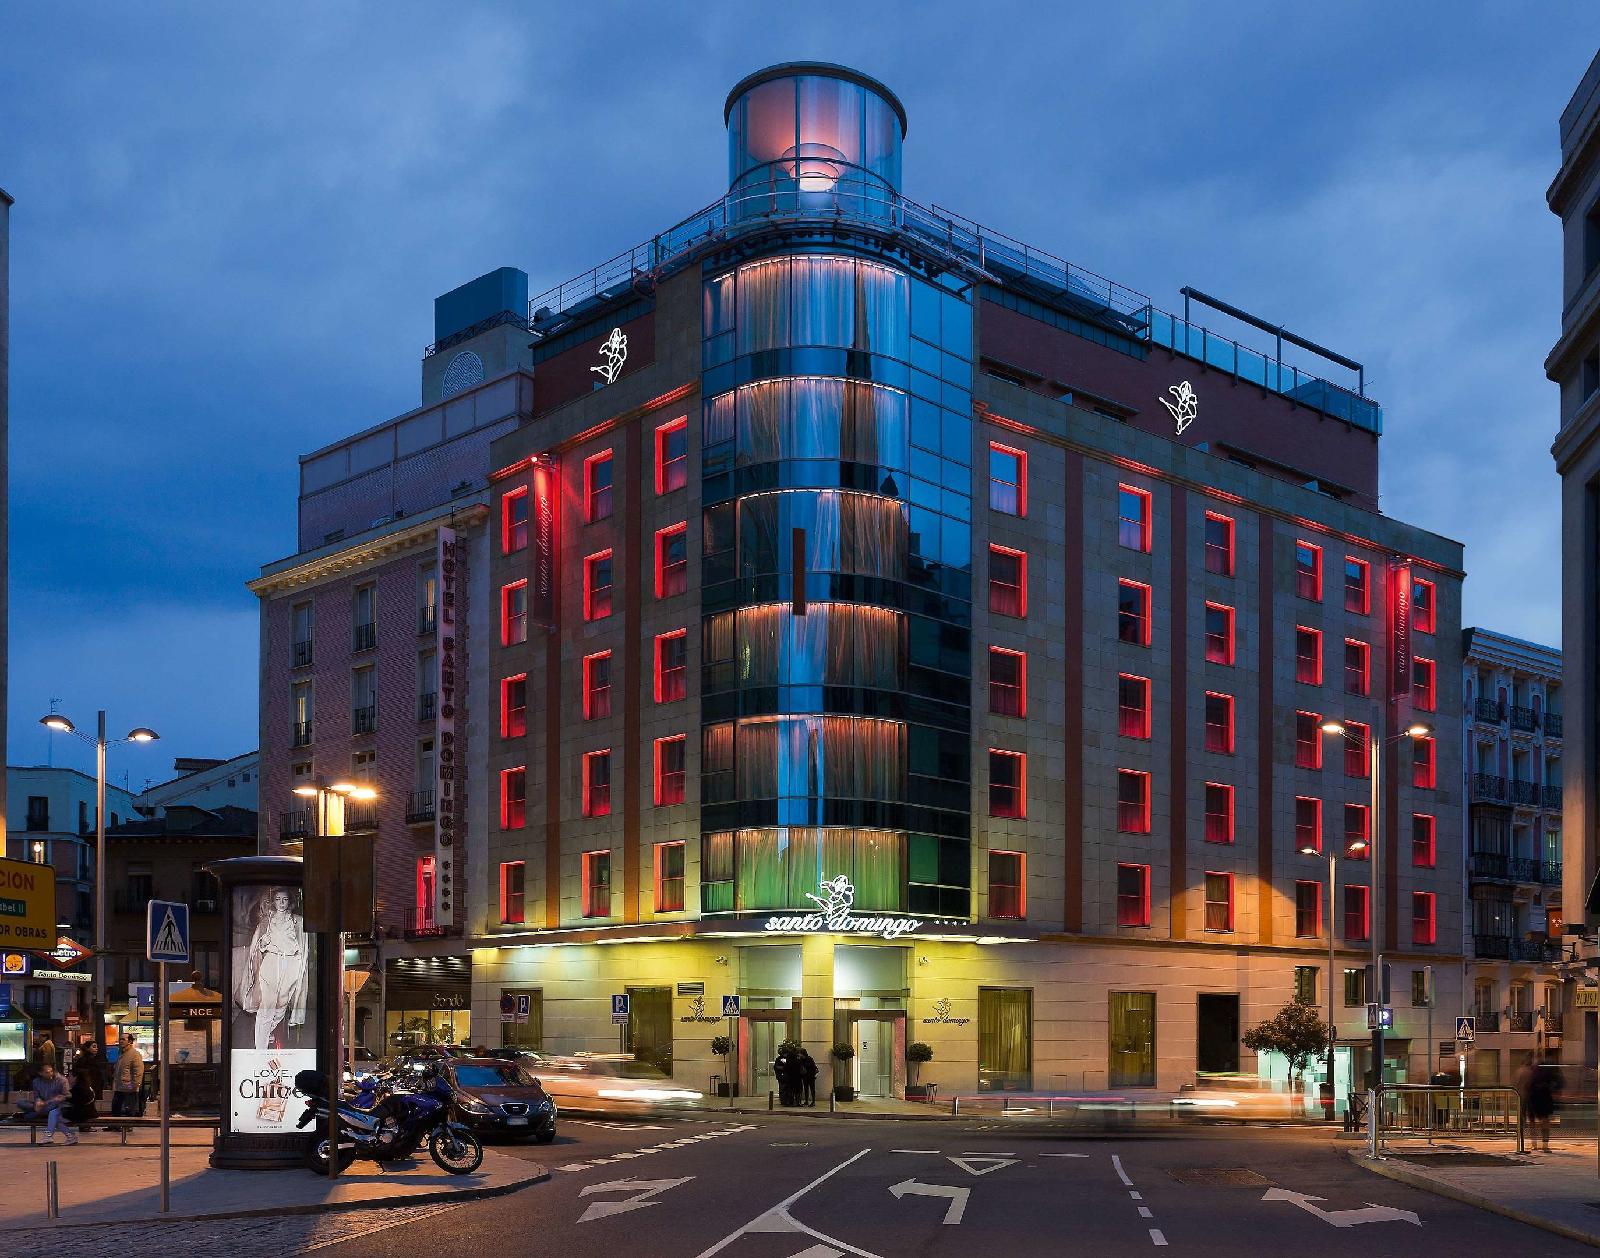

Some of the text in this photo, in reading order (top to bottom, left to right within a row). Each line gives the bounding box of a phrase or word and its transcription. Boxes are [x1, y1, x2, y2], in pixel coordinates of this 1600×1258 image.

[536, 495, 552, 557] domingo
[440, 541, 456, 847] HOTEL SANTO DOMINGO
[15, 926, 48, 939] OBRAS
[765, 907, 923, 940] santo domingo
[615, 995, 624, 1012] P
